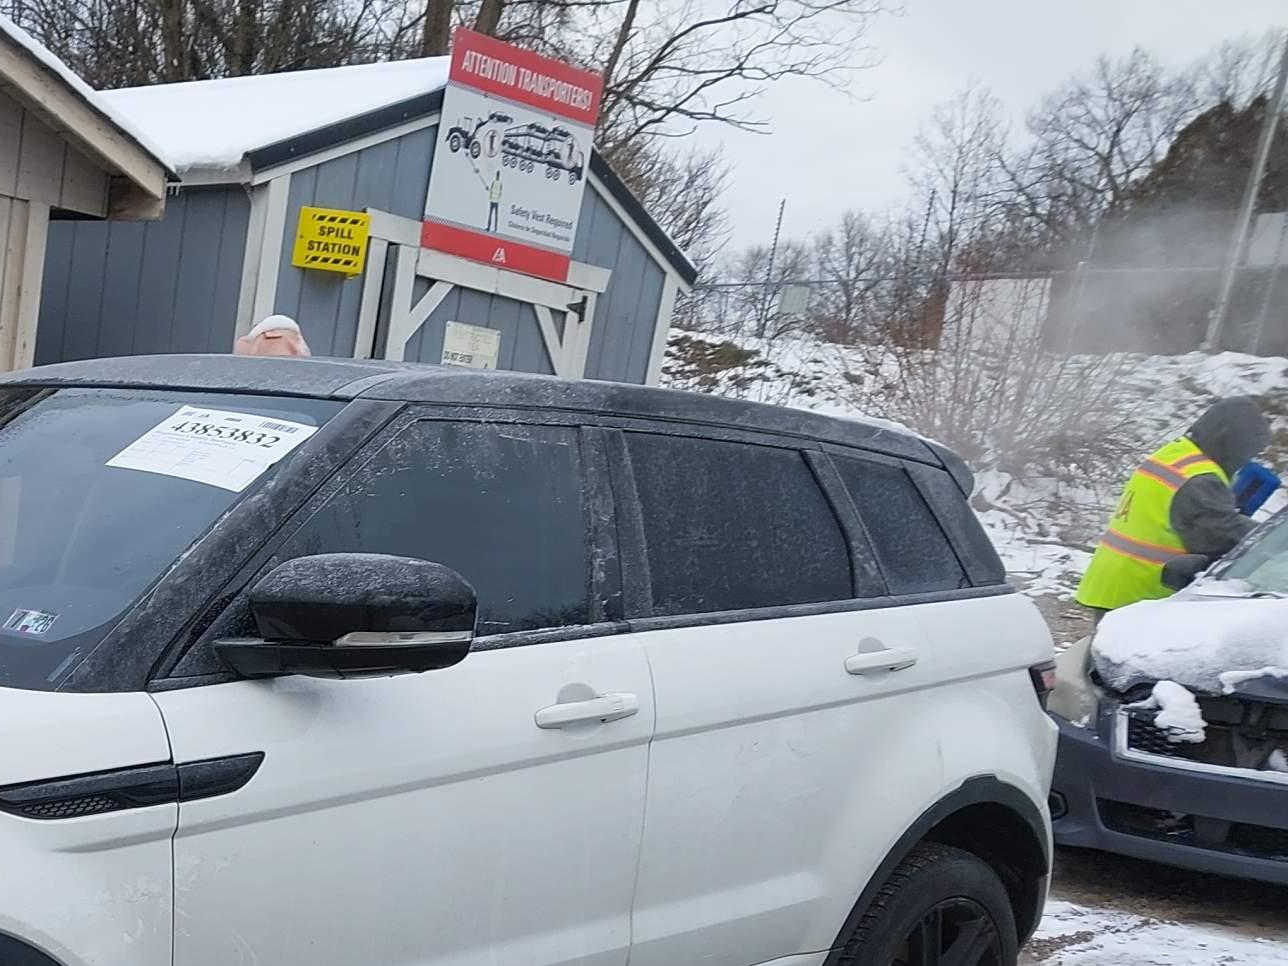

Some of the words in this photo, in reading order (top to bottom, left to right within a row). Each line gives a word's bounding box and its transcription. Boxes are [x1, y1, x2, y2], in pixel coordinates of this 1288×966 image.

[462, 50, 517, 86] ATTENTION
[518, 67, 593, 111] TRANSPORTERS!
[318, 225, 354, 240] SPILL
[307, 239, 361, 256] STATION
[171, 421, 281, 448] 43853832
